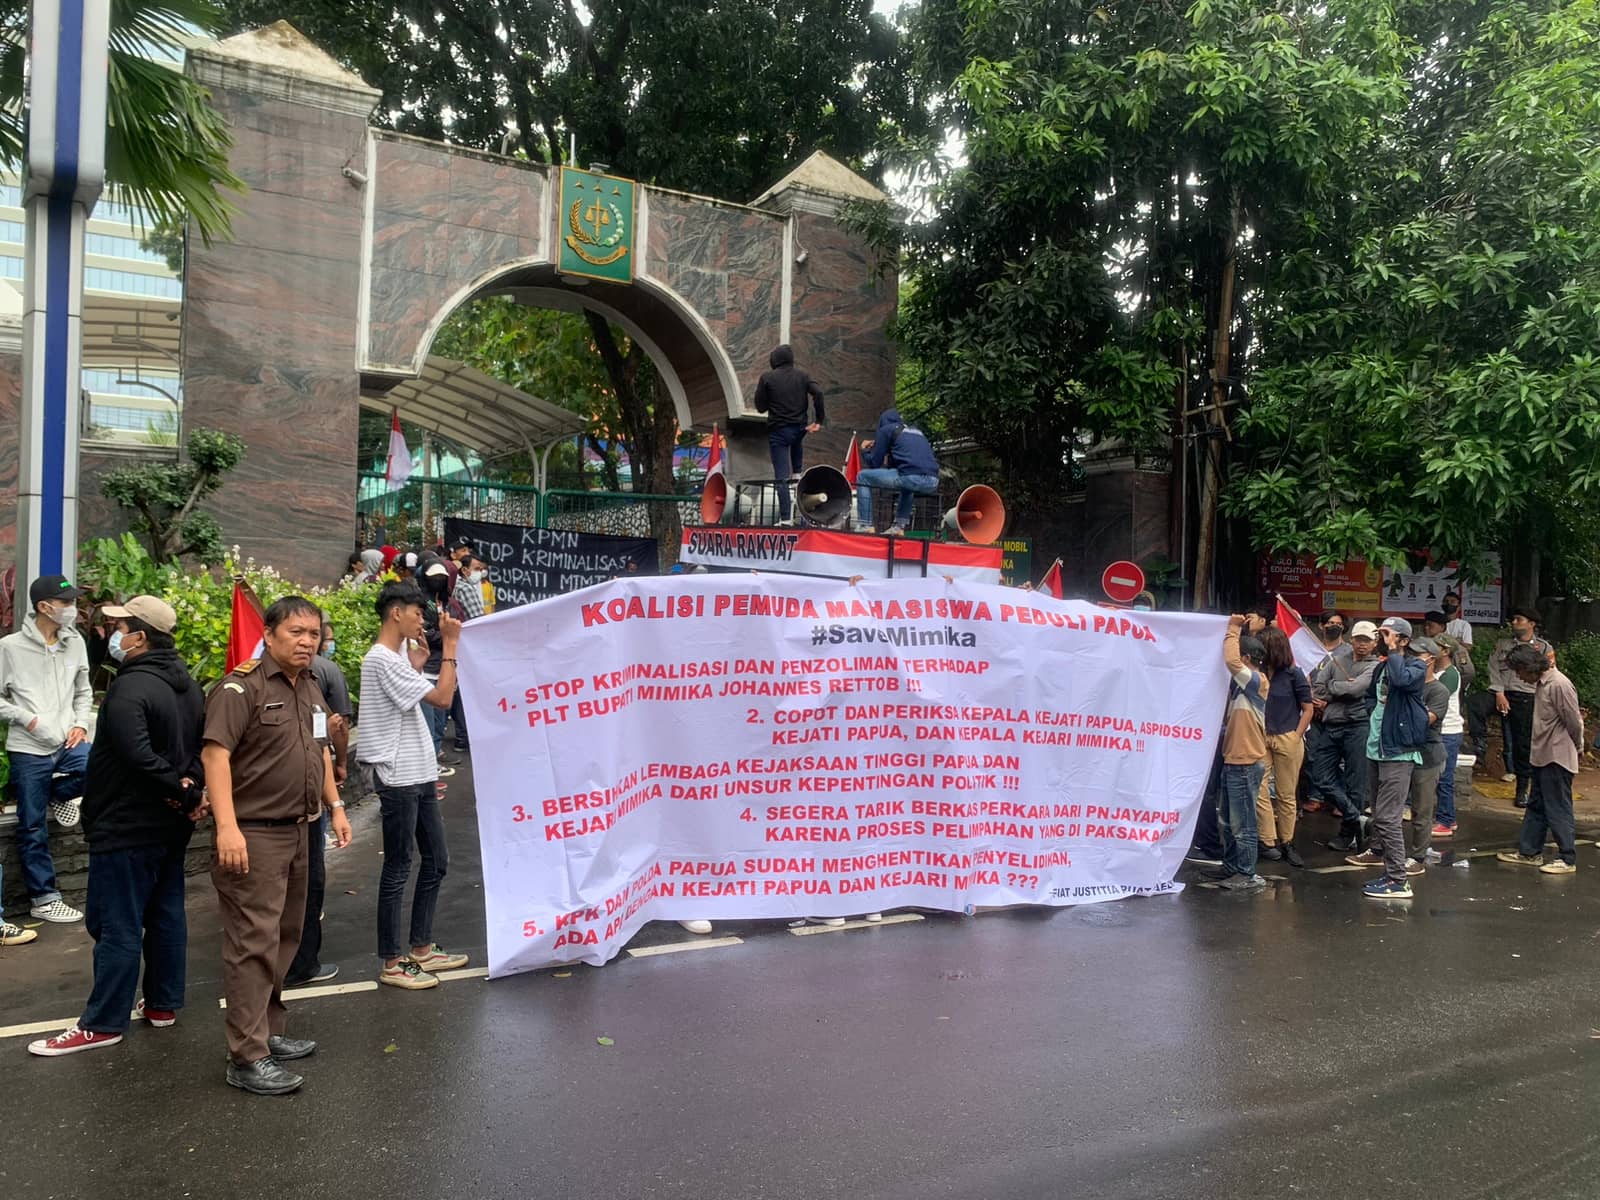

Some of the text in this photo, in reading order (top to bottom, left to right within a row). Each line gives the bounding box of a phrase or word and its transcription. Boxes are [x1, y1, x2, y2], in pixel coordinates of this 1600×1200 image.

[521, 528, 578, 549] KPMN
[688, 532, 798, 560] SUARA RAKYAT
[1003, 541, 1028, 552] MOBIL
[488, 565, 547, 588] BUPATI
[581, 594, 1157, 642] KOALISI PEMUDA MAHASISWA PEDULI PAPUA
[811, 624, 977, 647] #SaveMimika
[498, 656, 990, 713] 1. STOP KRIMINALISASI DAN PENZOLIMAN TERHADAP
[528, 705, 570, 727] PLT
[578, 690, 633, 719] BUPATI
[637, 681, 713, 701] MIMIKA
[719, 679, 822, 697] JOHANNES
[828, 677, 899, 693] RETTOB
[746, 704, 1203, 741] 2. COPOT DAN PERIKSA KEPALA KEJATI PAPUA, ASPIDSUS
[771, 726, 840, 745] KEJATI
[847, 725, 909, 742] PAPUA,
[915, 726, 955, 741] DAN
[959, 726, 1016, 742] KEPALA
[1023, 729, 1071, 745] KEJARI
[1076, 733, 1132, 751] MIMIKA
[512, 753, 1020, 822] 3. BERSIHKAN LEMBAGA KEJAKSAAN TINGGI PAPUA DAN
[544, 809, 617, 841] KEJARI
[617, 783, 662, 818] MIMIKA
[670, 783, 718, 801] DARI
[724, 777, 791, 797] UNSUR
[798, 773, 935, 792] KEPENTINGAN
[941, 775, 996, 790] POLITIK
[739, 807, 757, 822] 4.
[766, 805, 849, 821] SEGERA
[855, 801, 904, 819] TARIK
[911, 800, 978, 817] BERKAS
[980, 801, 1050, 819] PERKARA
[1053, 804, 1081, 818] DARI
[1086, 805, 1109, 820] PN
[765, 826, 851, 842] KARENA
[857, 821, 925, 840] PROSES
[932, 822, 1034, 840] PELIMPAHAN
[1040, 823, 1065, 838] YANG
[1068, 823, 1081, 837] DI
[523, 920, 544, 937] 5.
[555, 905, 600, 930] KPK
[605, 886, 630, 916] DAN
[669, 861, 736, 877] PAPUA
[744, 858, 815, 874] SUDAH
[822, 850, 971, 873] MENGHENTIKAN
[1072, 885, 1120, 897] JUSTITIA
[554, 930, 599, 949] ADA
[682, 880, 756, 897] KEJATI
[764, 880, 832, 896] PAPUA
[839, 876, 875, 894] DAN
[881, 871, 947, 889] KEJARI
[955, 870, 1000, 890] MIKA
[1007, 872, 1038, 890] ???
